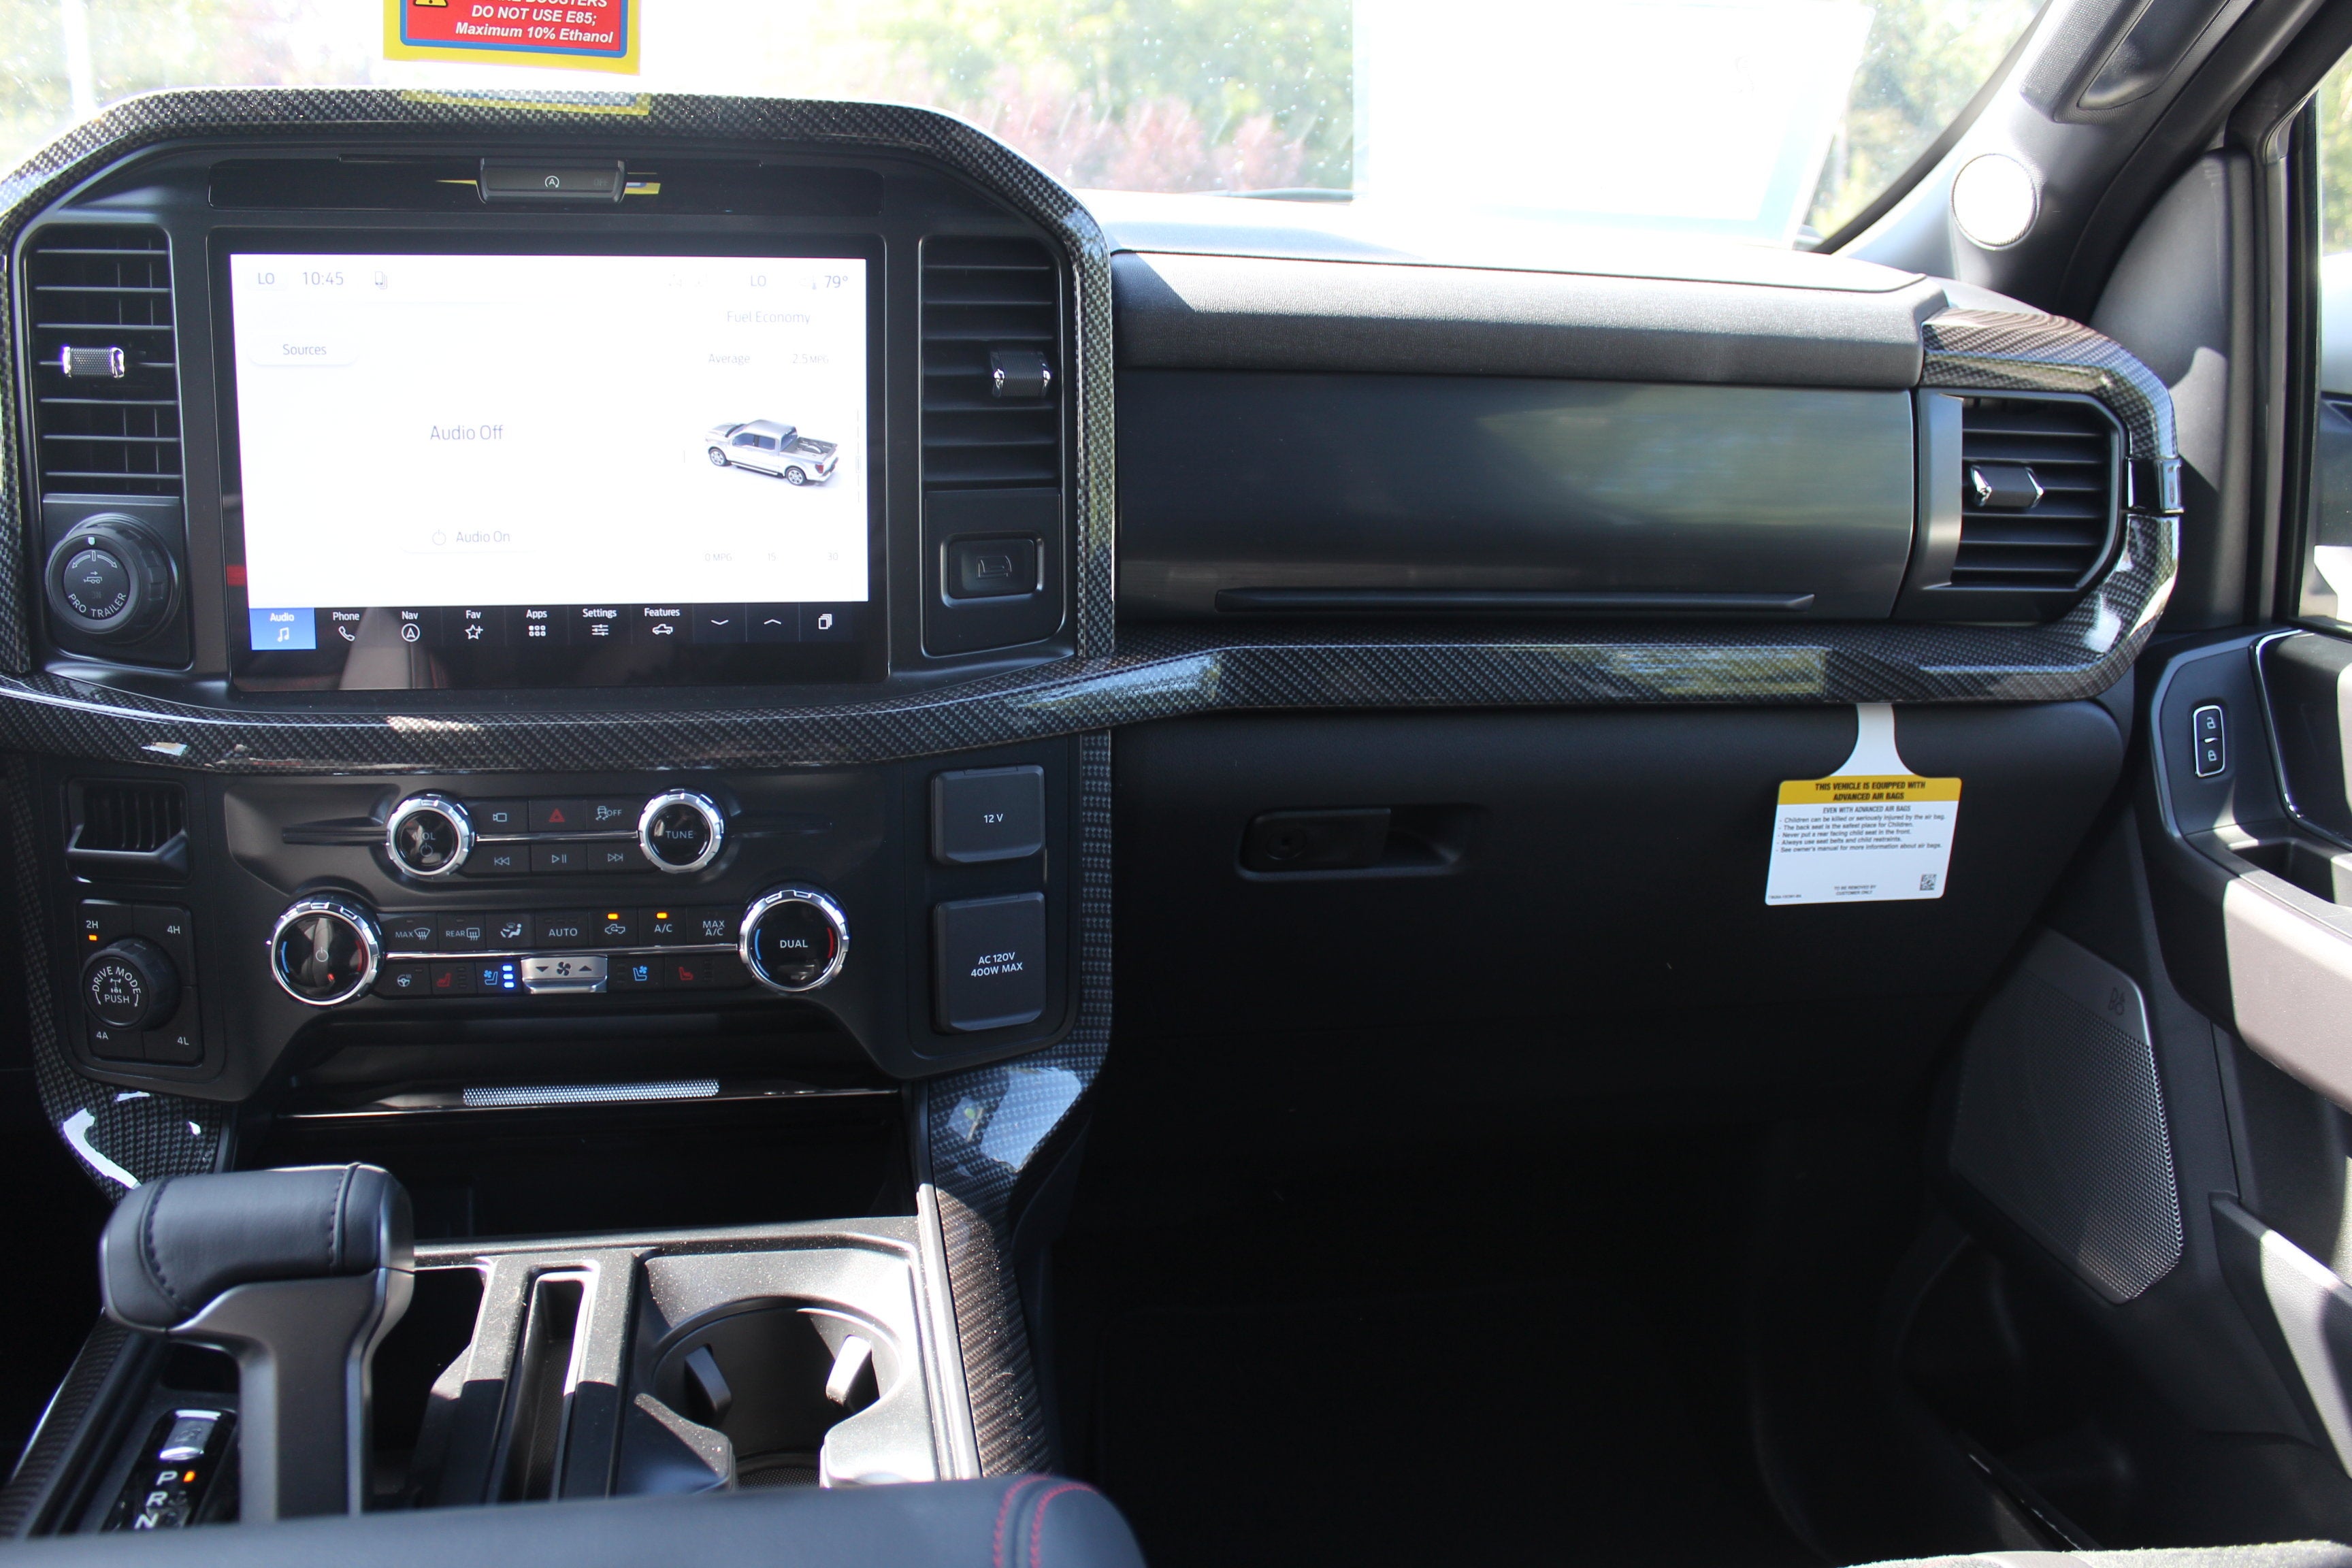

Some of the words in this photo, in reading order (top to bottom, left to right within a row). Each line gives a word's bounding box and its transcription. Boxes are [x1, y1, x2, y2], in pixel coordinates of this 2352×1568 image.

[472, 5, 494, 18] DO
[497, 6, 529, 20] NOT
[532, 9, 563, 22] USE
[566, 11, 597, 26] E85;
[455, 22, 523, 37] Maximum
[527, 26, 556, 40] 10%
[559, 28, 613, 44] Ethanol
[257, 272, 275, 285] LO
[302, 272, 344, 286] 10:45
[751, 275, 766, 287] LO
[726, 310, 752, 323] Fuel
[755, 310, 811, 325] Economy
[282, 343, 327, 356] Sources
[708, 353, 750, 365] Average
[429, 425, 476, 441] Audio
[479, 424, 504, 441] Off
[455, 531, 490, 543] Audio
[493, 530, 510, 542] On
[68, 593, 86, 613] PRO
[91, 592, 127, 618] TRAILER
[270, 612, 295, 622] Audio
[333, 610, 360, 621] Phone
[402, 610, 419, 620] Nav
[466, 609, 481, 619] Fav
[526, 608, 547, 620] Apps
[582, 607, 617, 619] Settings
[644, 606, 681, 618] Features
[1815, 783, 1831, 791] THIS
[1833, 782, 1861, 791] VEHICLE
[1863, 781, 1870, 789] IS
[1872, 781, 1906, 789] EQUIPPED
[1908, 781, 1926, 789] WITH
[1833, 793, 1871, 801] ADVANCED
[1872, 792, 1884, 800] AIR
[1886, 791, 1904, 800] BAGS
[983, 814, 994, 823] 12
[996, 813, 1004, 822] V
[413, 831, 436, 840] VOL
[666, 830, 693, 839] TUNE
[86, 920, 99, 929] 2H
[167, 926, 180, 934] 4H
[654, 924, 673, 934] A/C
[702, 920, 725, 929] MAX
[549, 928, 578, 937] AUTO
[706, 928, 723, 936] A/C
[779, 939, 808, 949] DUAL
[978, 955, 991, 965] AC
[993, 951, 1015, 964] 120V
[970, 966, 999, 977] 400W
[1002, 962, 1023, 974] MAX
[92, 966, 114, 992] DRIVE
[115, 966, 142, 994] MODE
[105, 994, 130, 1004] PUSH
[96, 1031, 109, 1040] 4A
[177, 1036, 189, 1045] 4L
[156, 1471, 178, 1486] P
[146, 1491, 168, 1507] R
[134, 1512, 159, 1529] N
